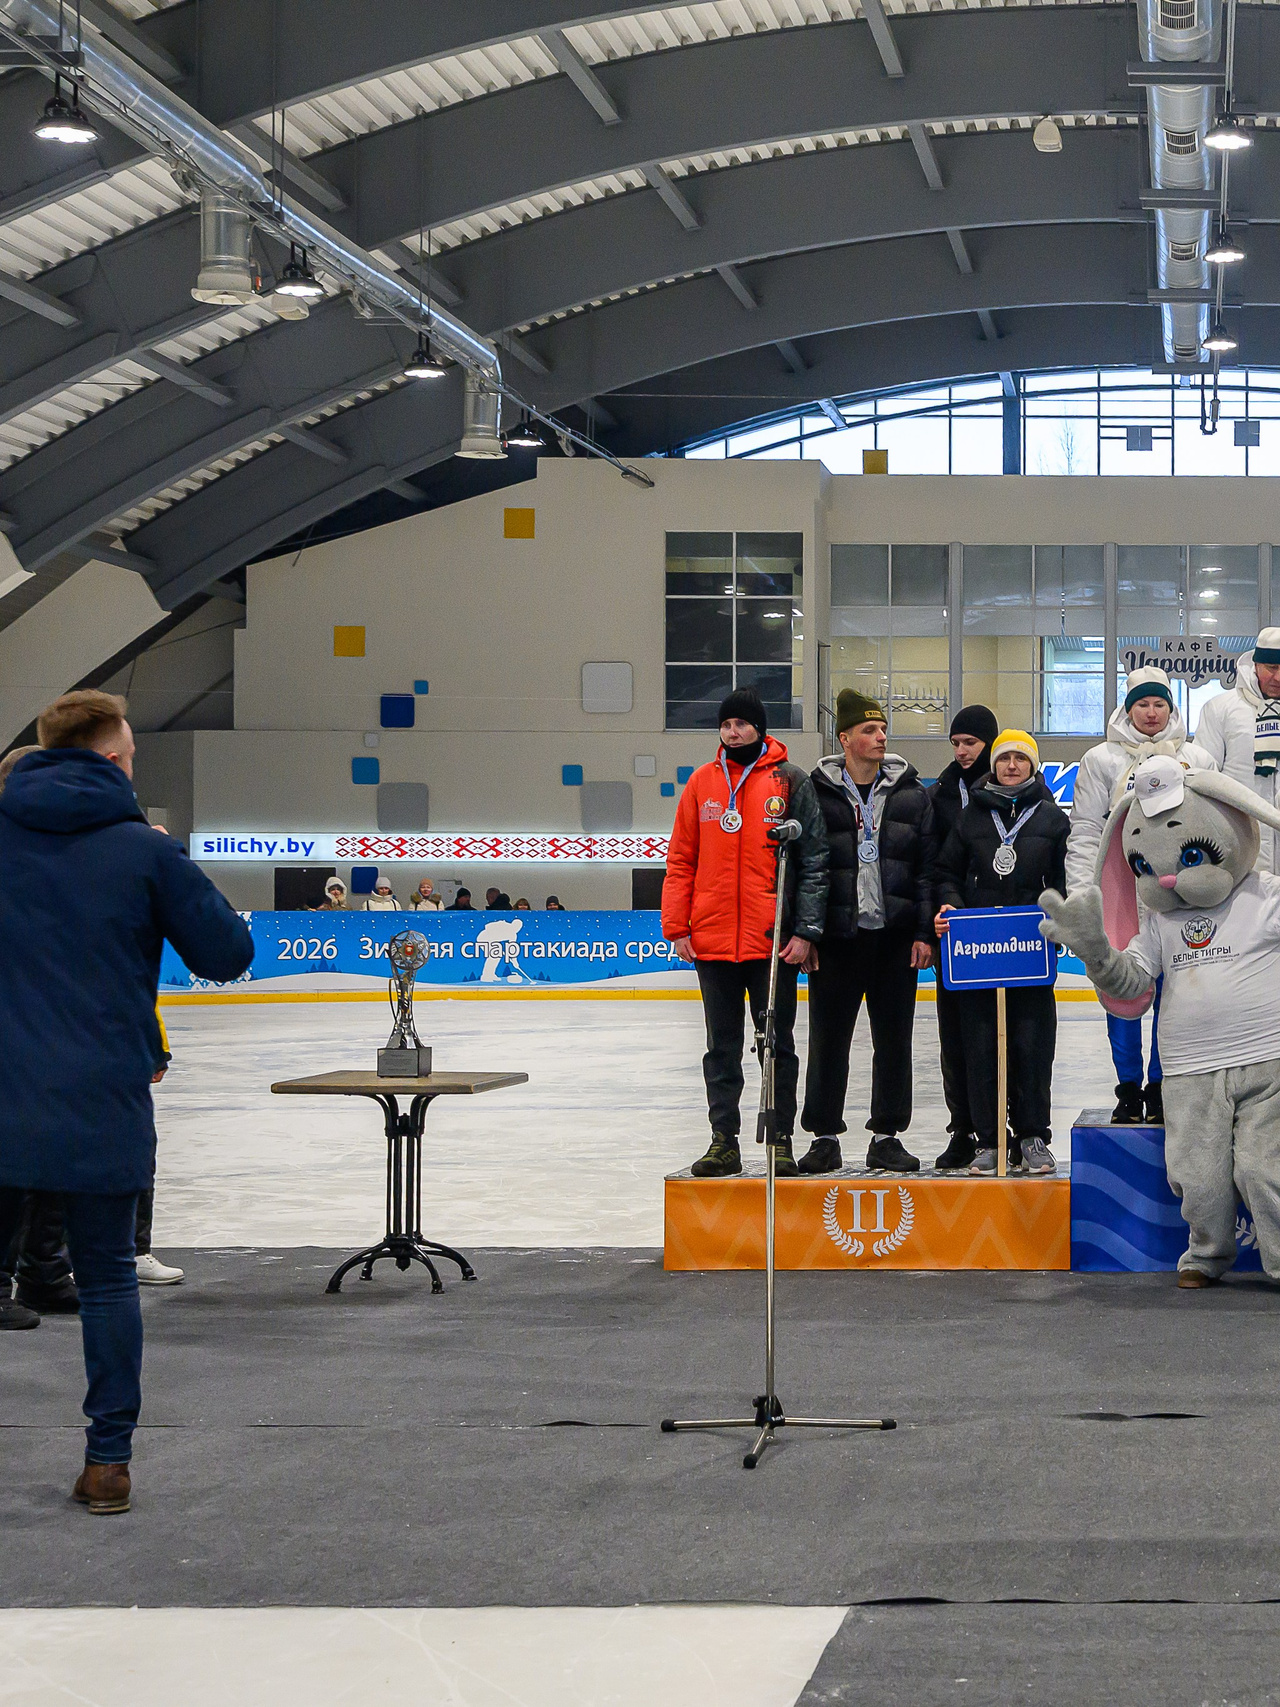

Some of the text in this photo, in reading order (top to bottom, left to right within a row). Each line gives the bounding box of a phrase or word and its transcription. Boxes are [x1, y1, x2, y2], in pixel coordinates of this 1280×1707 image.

[1165, 641, 1213, 652] КАФЕ
[1125, 650, 1237, 684] Цараўніц
[1256, 722, 1279, 732] БЕЛЫЕ
[203, 837, 315, 857] silichy.by
[277, 937, 338, 960] 2026
[358, 936, 453, 960] Зияя
[460, 940, 618, 963] спартакиада
[953, 936, 1042, 959] Агрохолдинг
[1172, 950, 1199, 964] БЕЛЫЕ
[1200, 945, 1231, 957] ТИГРЫ
